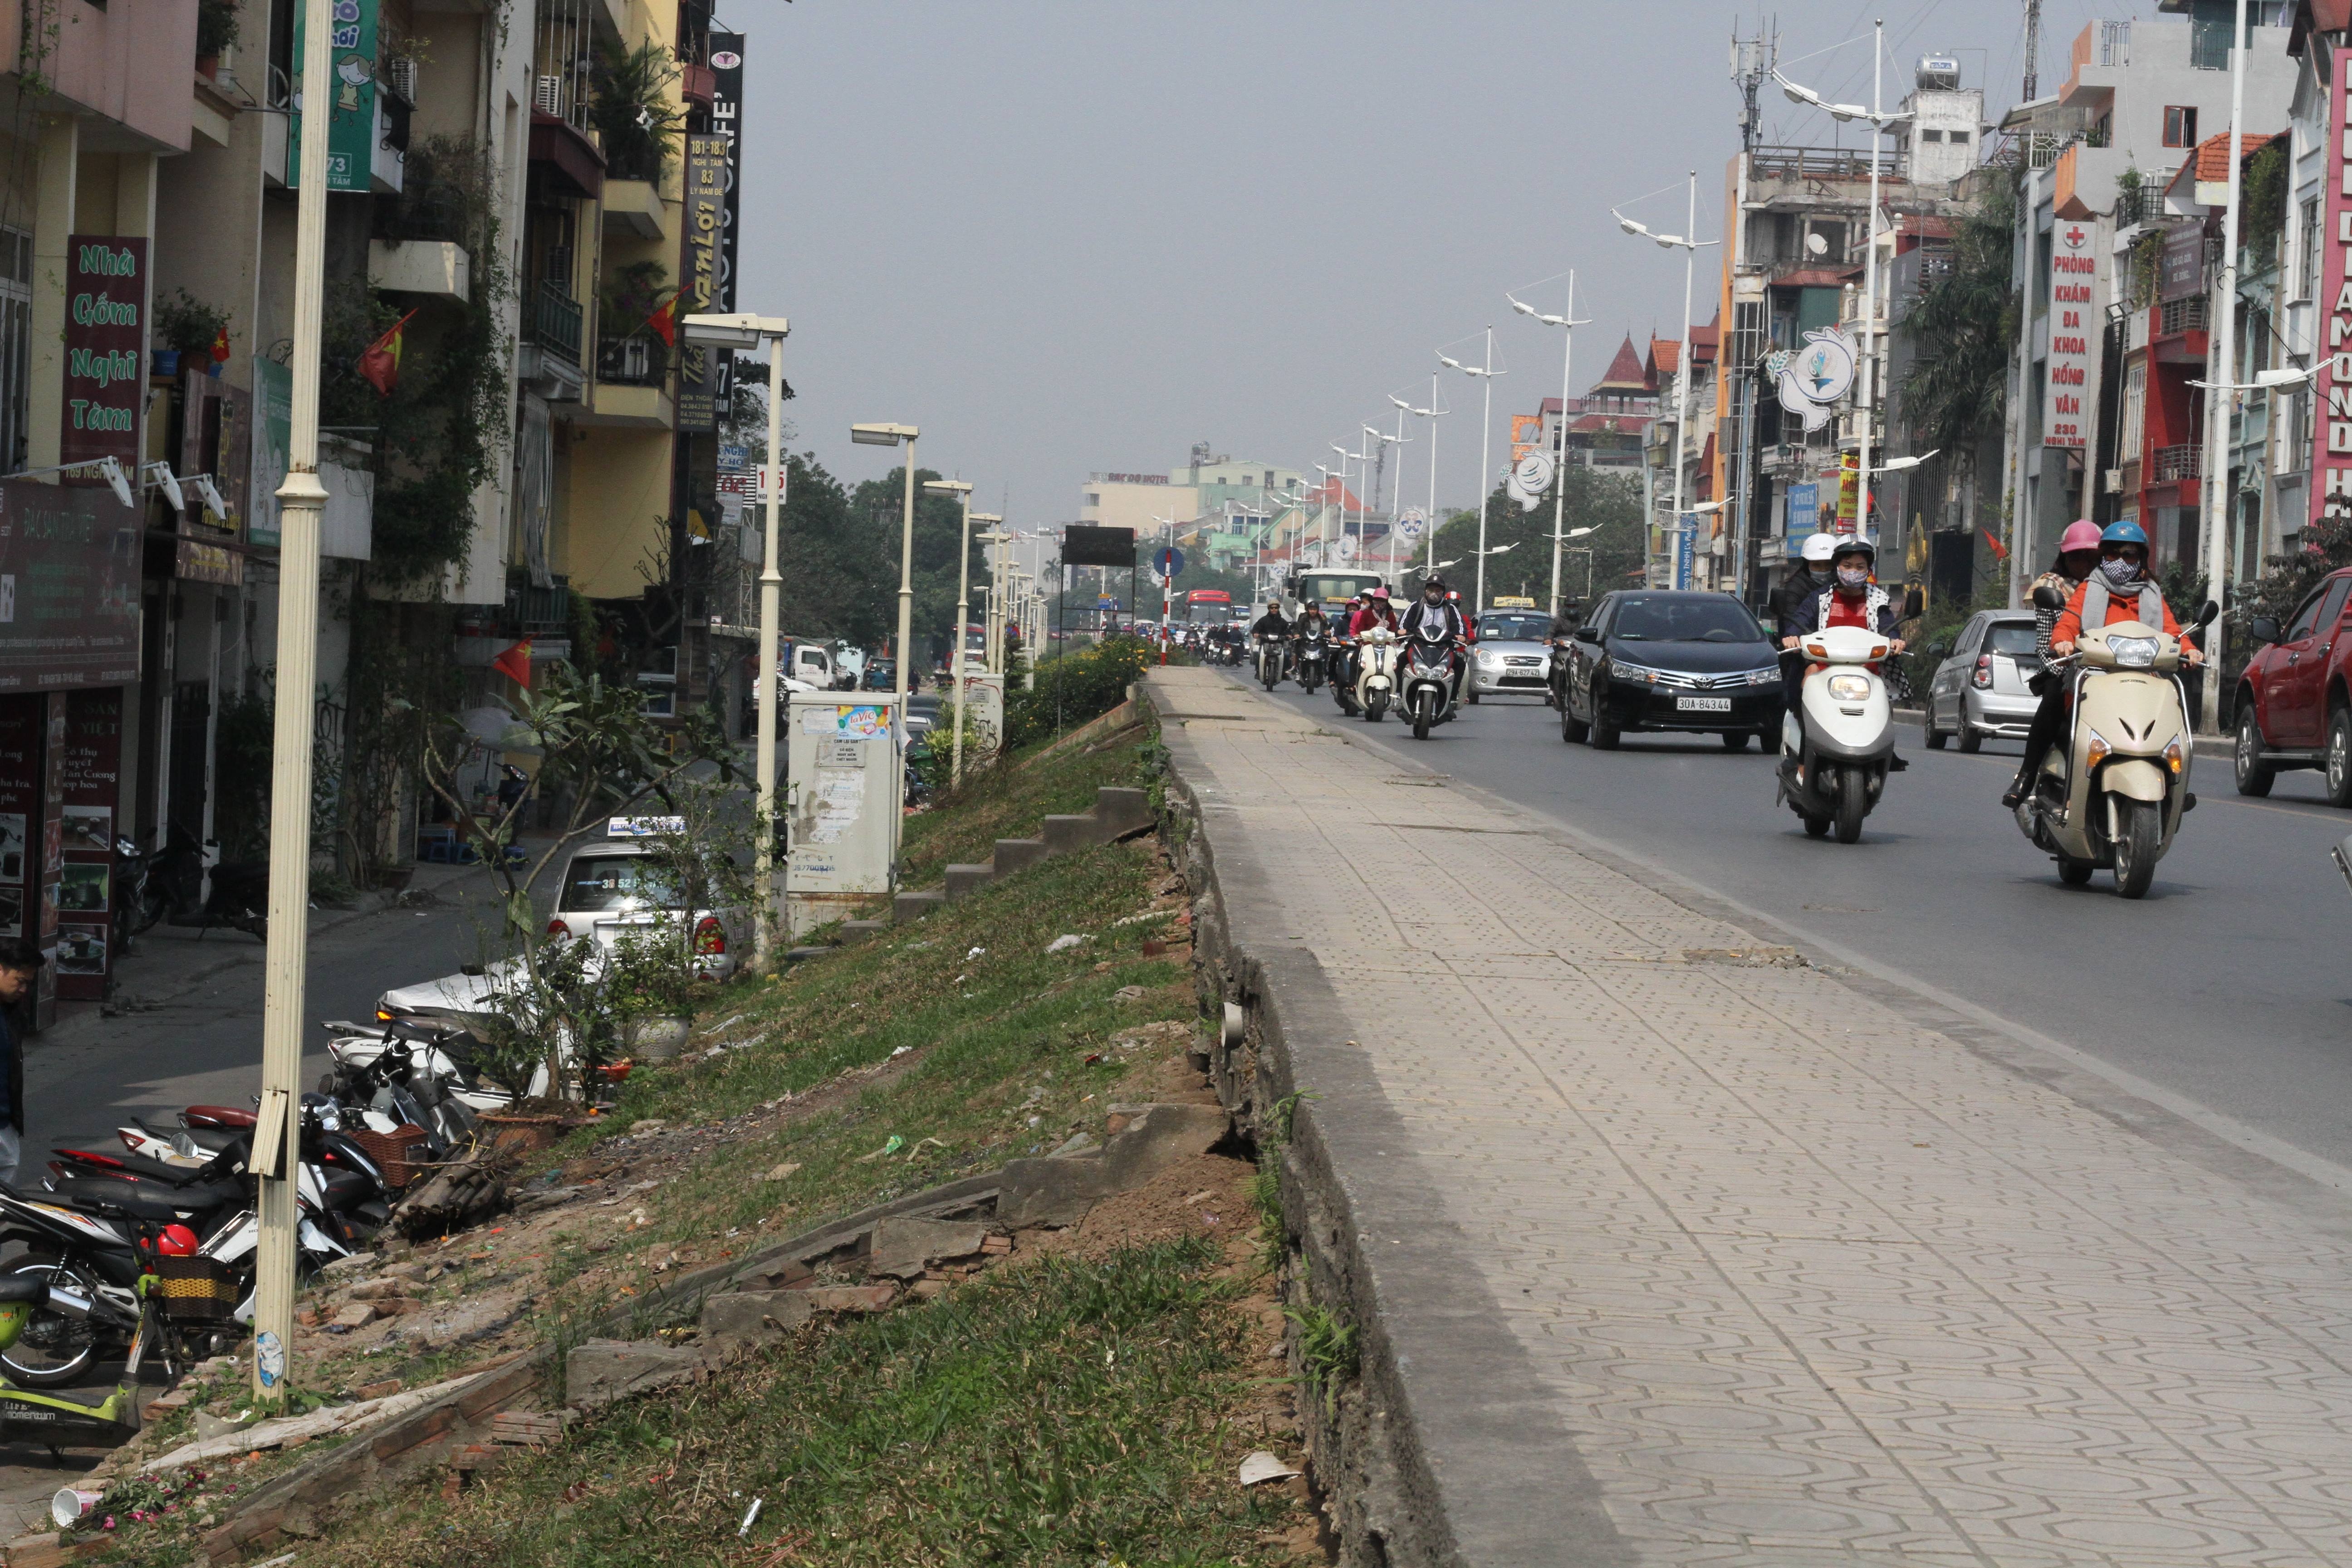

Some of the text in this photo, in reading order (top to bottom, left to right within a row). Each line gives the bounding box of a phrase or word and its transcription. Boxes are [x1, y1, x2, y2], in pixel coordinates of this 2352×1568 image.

[691, 140, 726, 156] 181-183
[701, 169, 714, 184] 83
[79, 244, 136, 277] Nhà
[2054, 254, 2094, 274] PHÒNG
[2055, 284, 2090, 302] KHÁM
[73, 292, 137, 326] Gốm
[2063, 311, 2080, 328] ĐA
[2053, 336, 2086, 354] KHOA
[70, 348, 137, 388] Nghi
[2052, 361, 2084, 386] HỒNG
[2055, 394, 2079, 414] VÂN
[70, 399, 132, 431] Tàm
[2054, 424, 2078, 435] 230
[2045, 435, 2085, 447] NGHI TÀM
[1679, 699, 1729, 710] 30A-843.44
[602, 879, 615, 889] 38
[617, 878, 631, 888] 52
